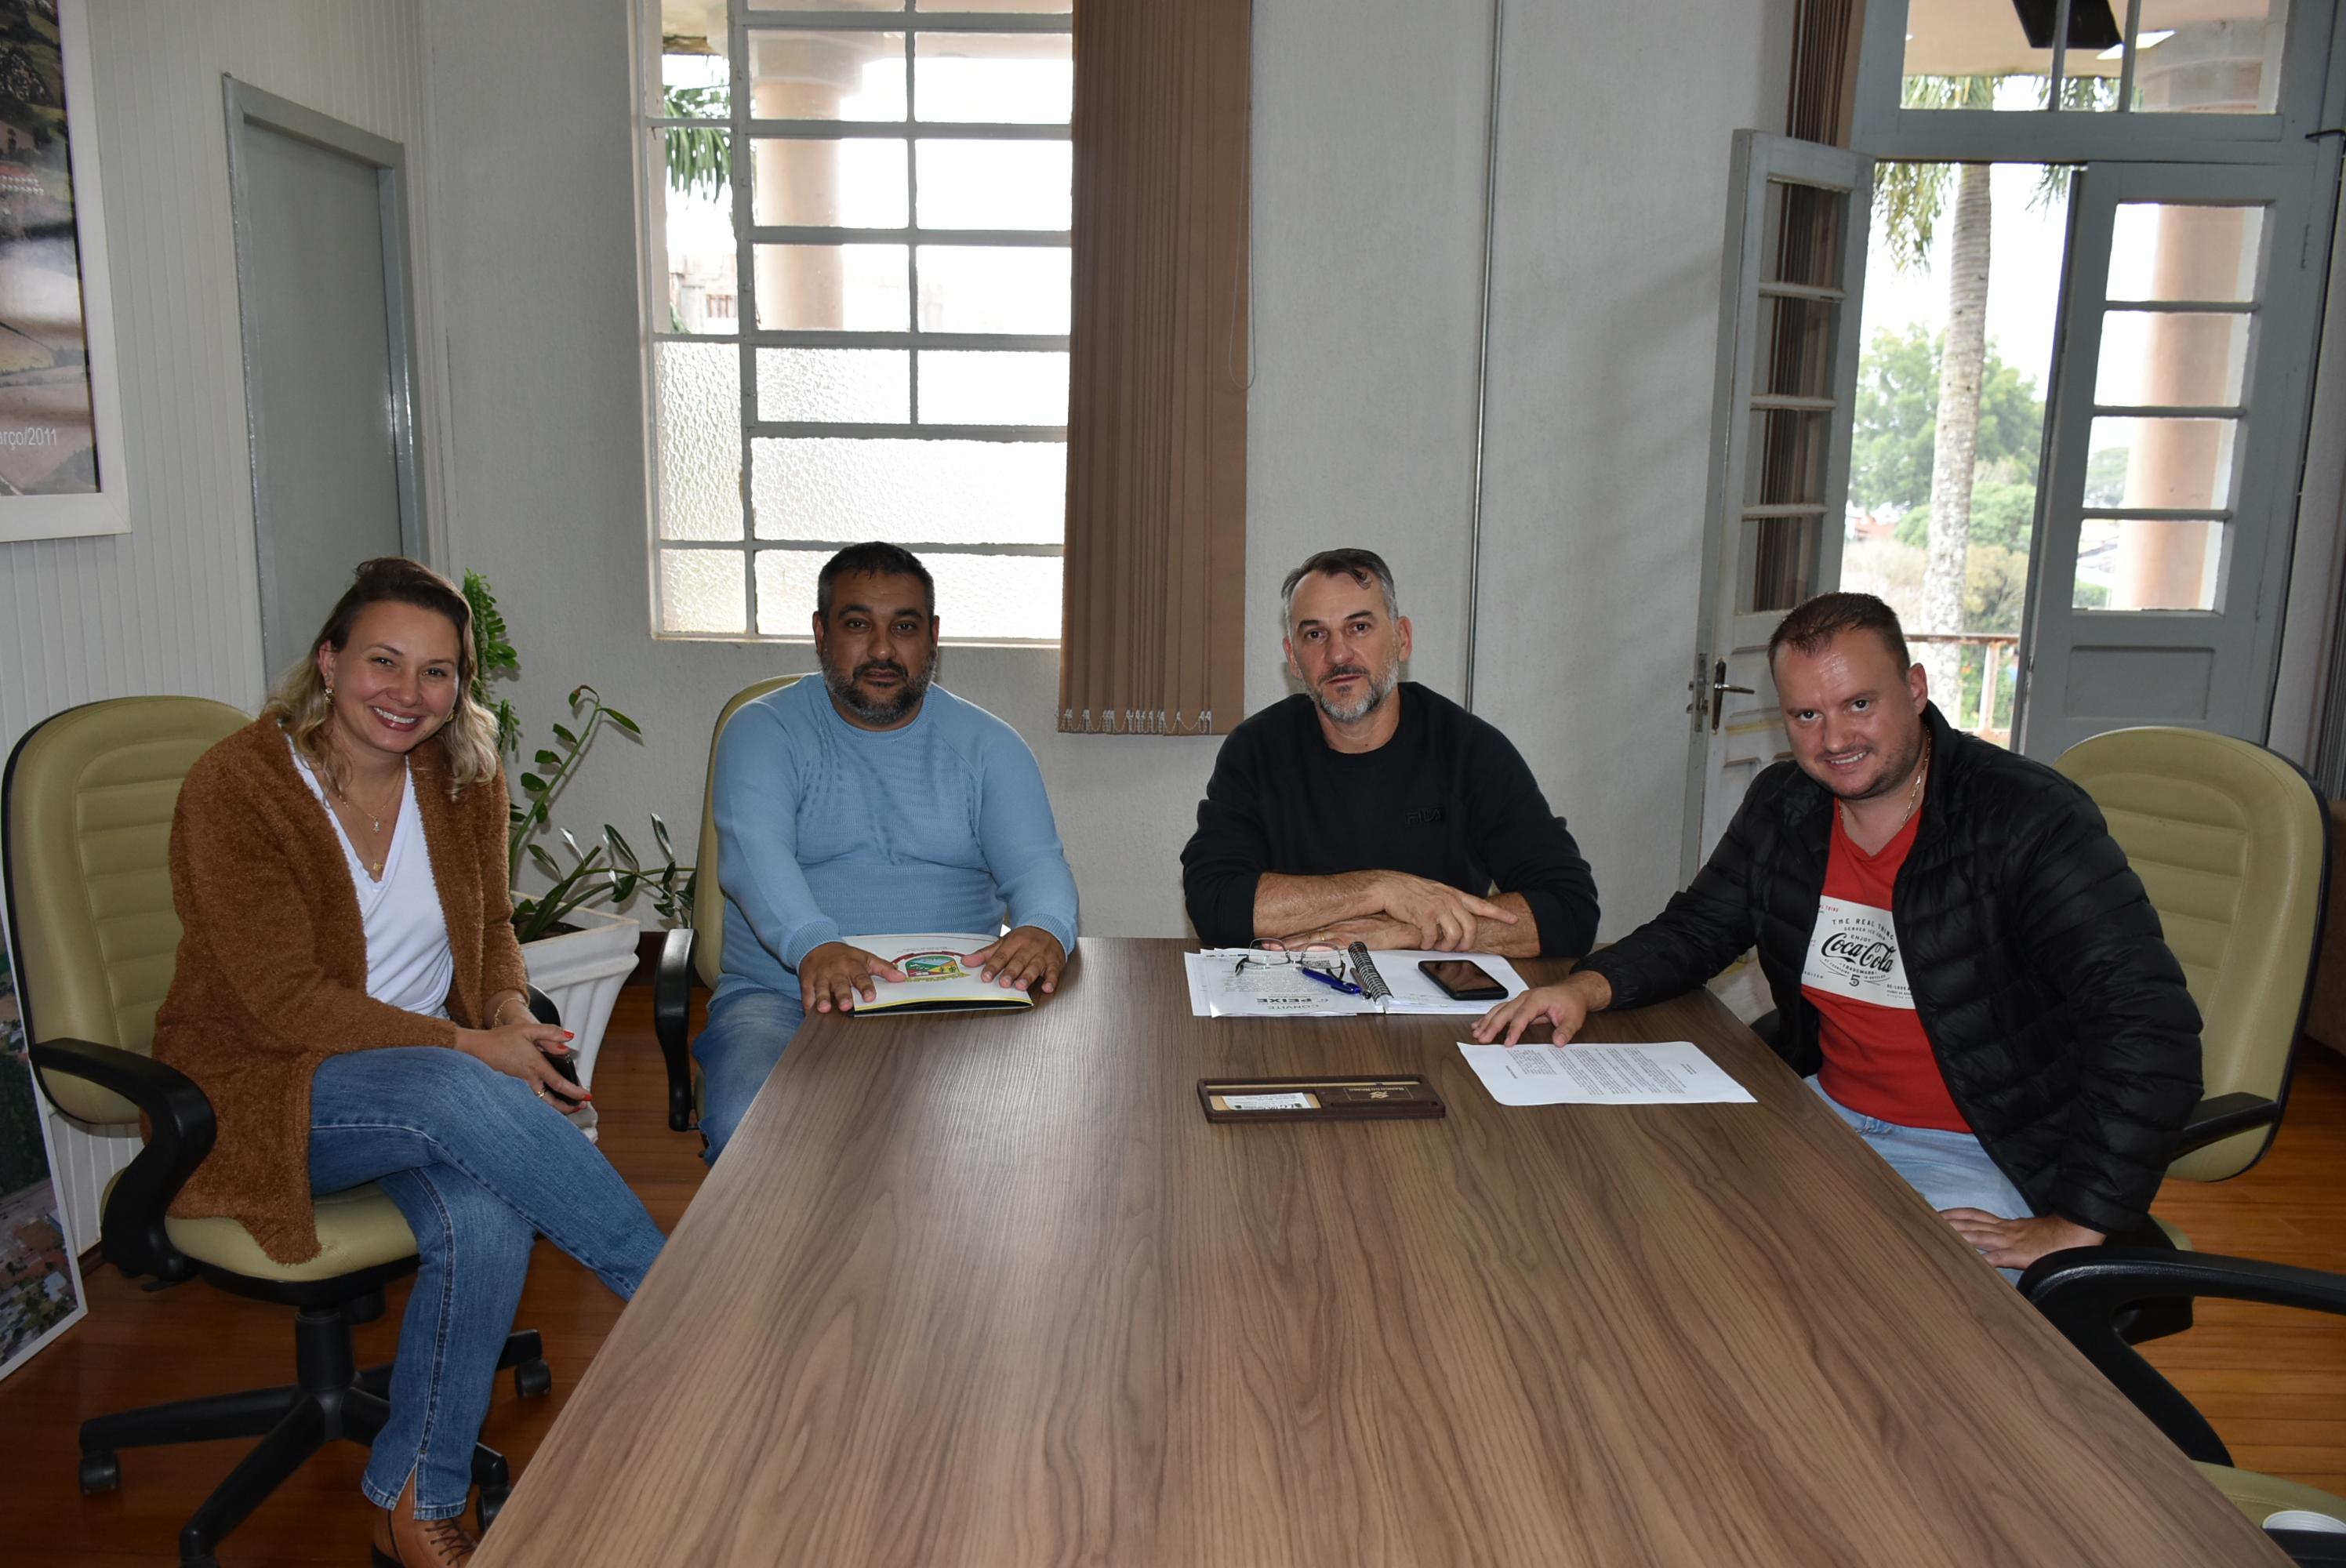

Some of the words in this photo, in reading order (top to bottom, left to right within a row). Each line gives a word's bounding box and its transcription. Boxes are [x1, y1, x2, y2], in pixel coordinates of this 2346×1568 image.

[1405, 808, 1441, 826] FILA
[1856, 918, 1875, 927] REAL
[1878, 924, 1894, 940] THING
[1876, 932, 1886, 941] COLD
[1850, 934, 1872, 943] ENJOY
[1821, 932, 1897, 973] Coca-Cola
[1849, 975, 1861, 987] 5
